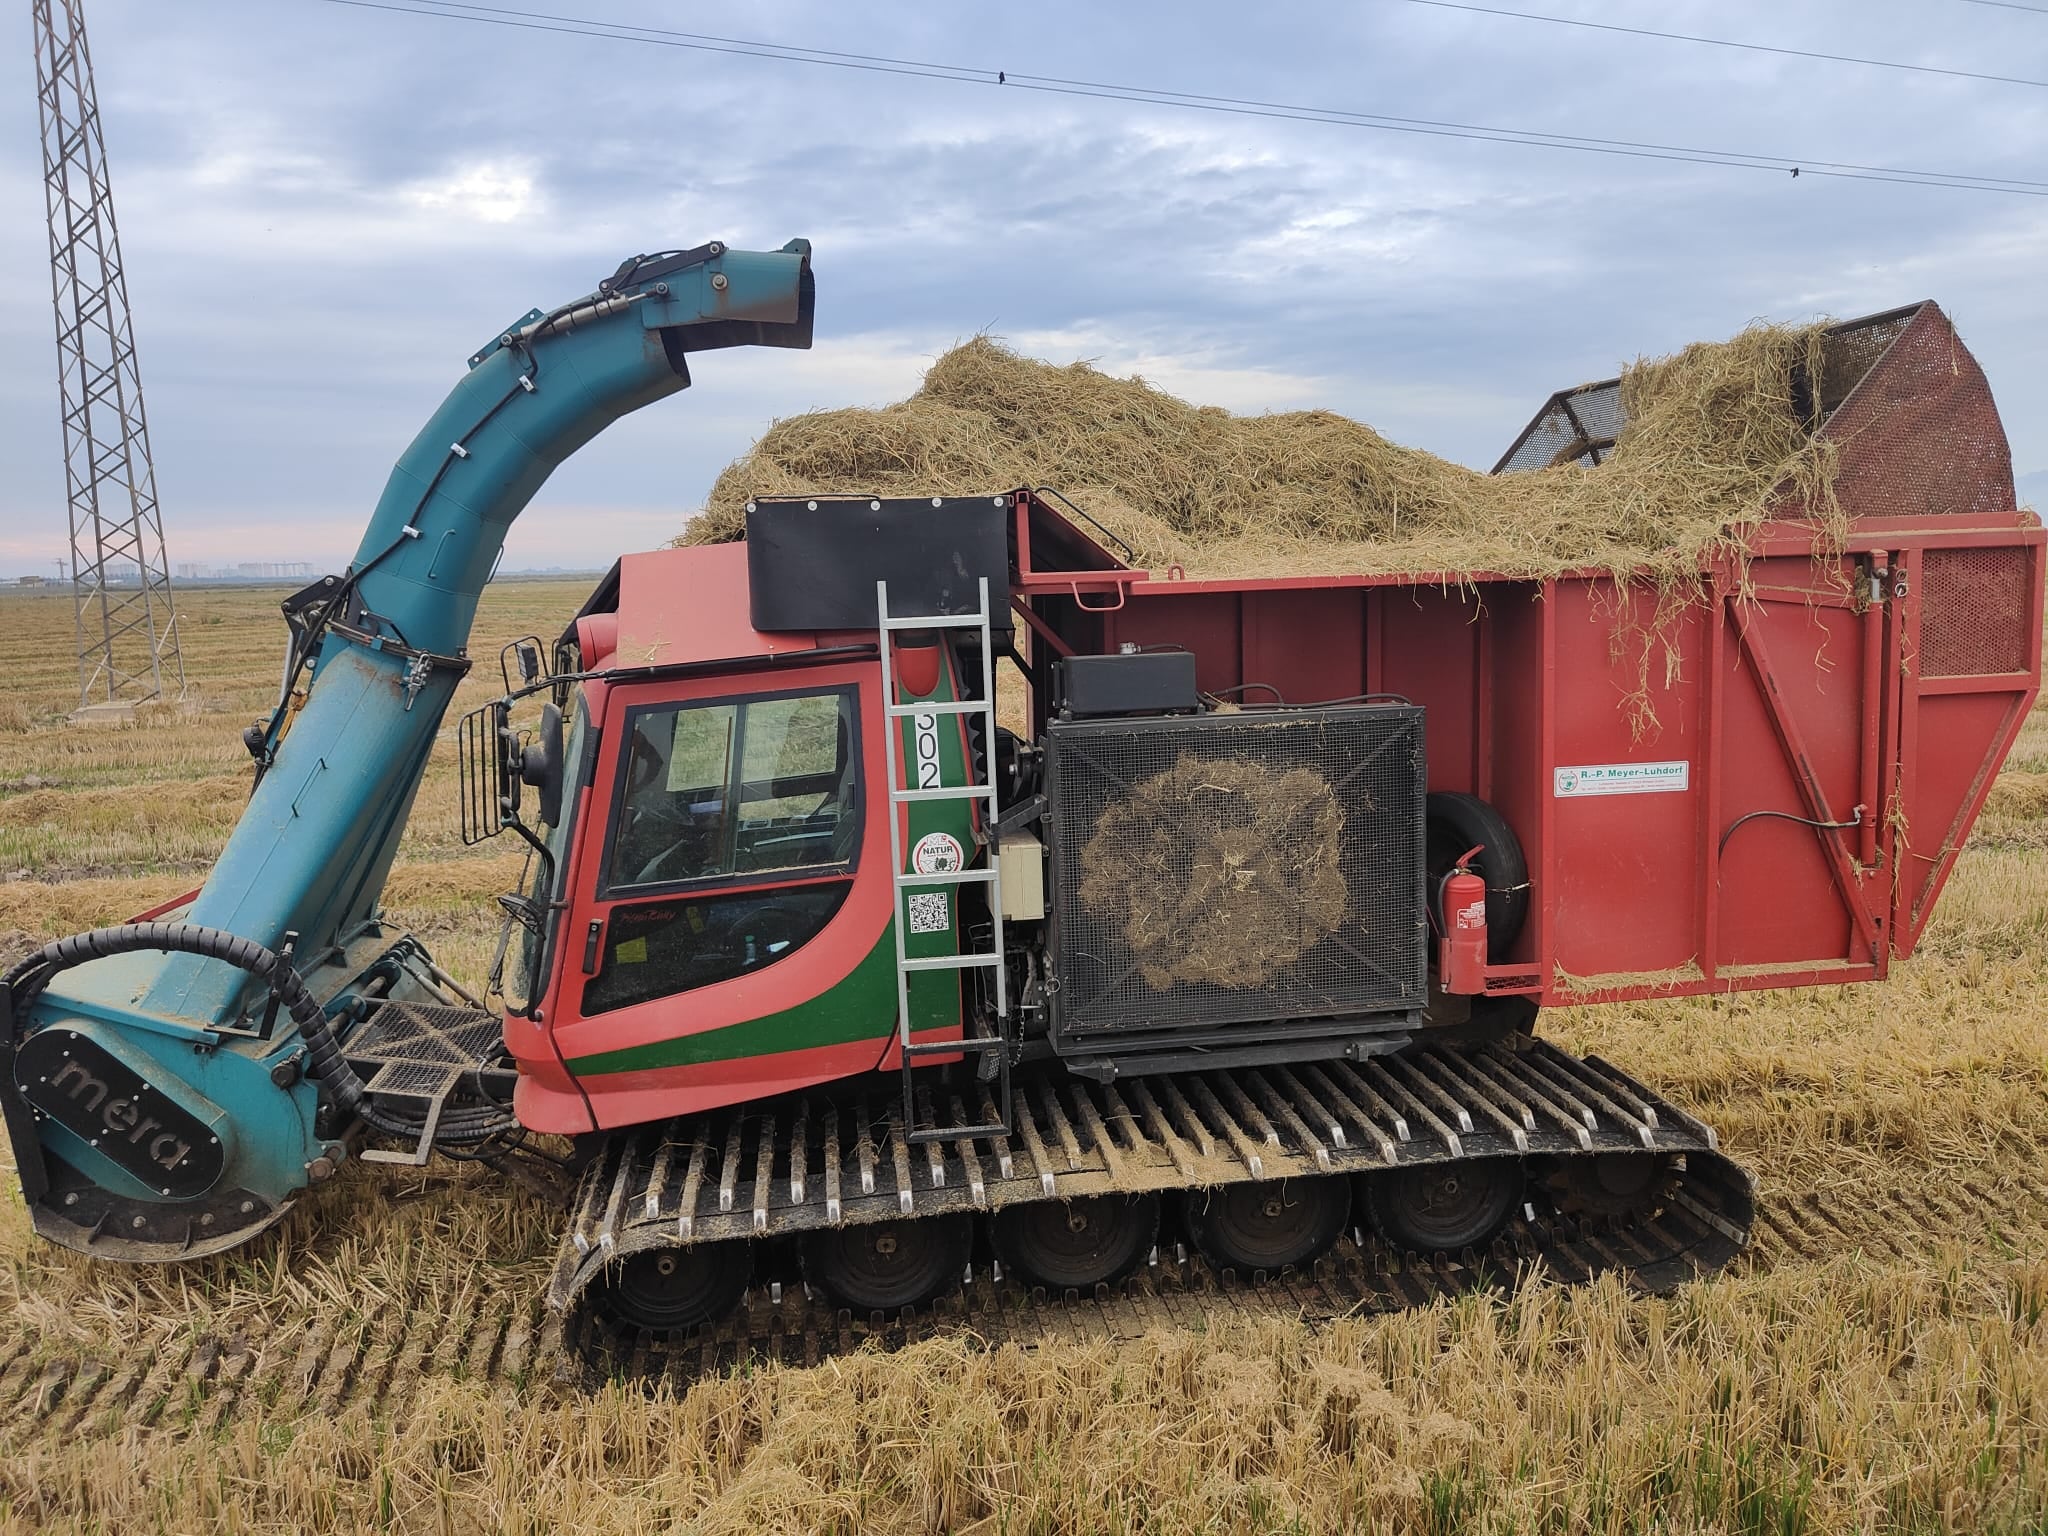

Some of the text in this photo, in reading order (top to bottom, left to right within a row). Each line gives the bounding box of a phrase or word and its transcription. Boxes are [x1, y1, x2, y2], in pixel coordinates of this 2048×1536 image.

[1608, 766, 1683, 778] Meyer-Luhdorf
[923, 846, 953, 855] NATUR
[51, 1060, 191, 1171] mera
